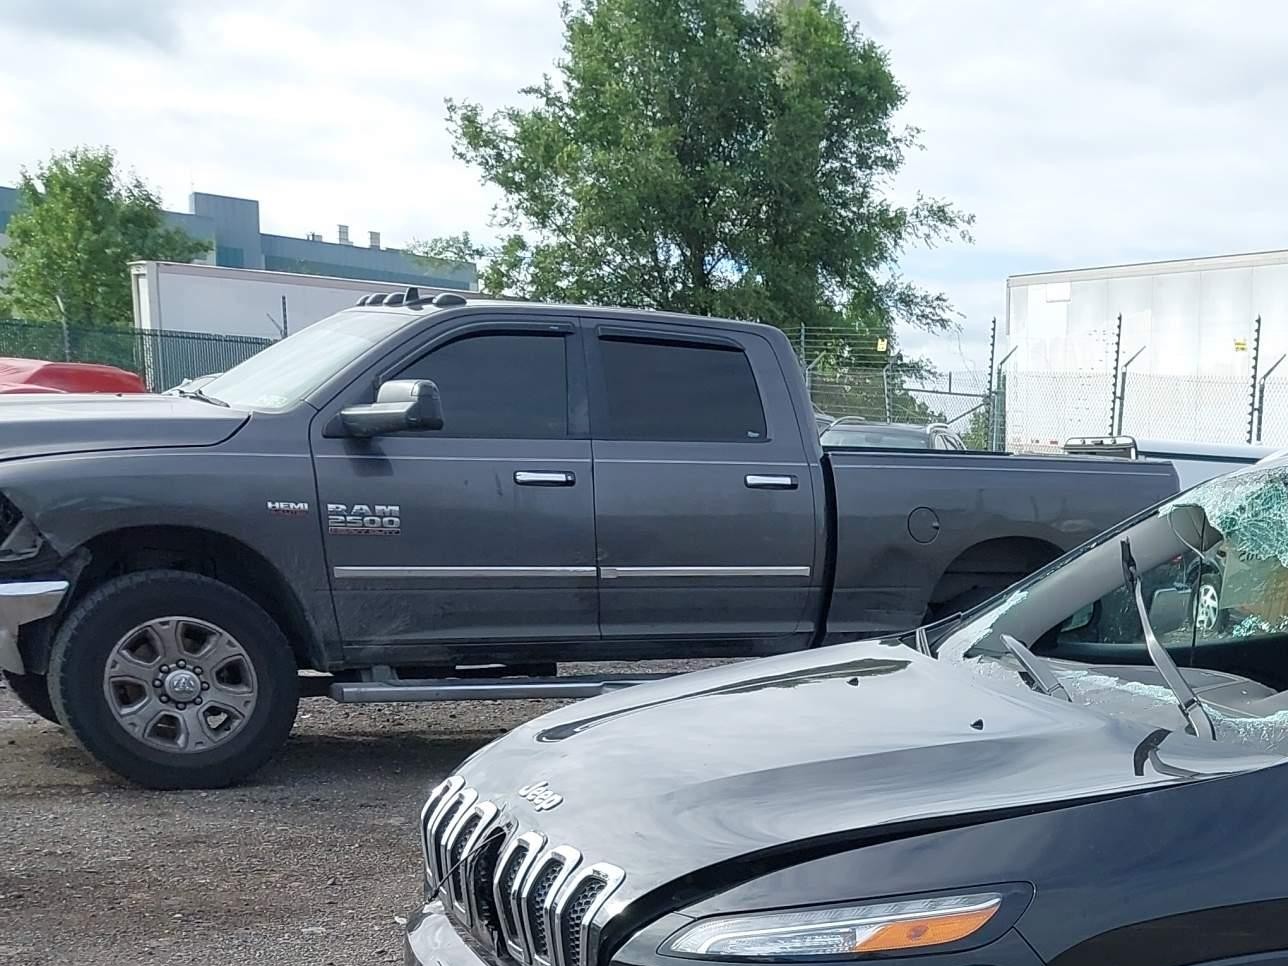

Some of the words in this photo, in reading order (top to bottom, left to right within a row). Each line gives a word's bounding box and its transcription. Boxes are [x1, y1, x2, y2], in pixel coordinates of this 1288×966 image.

[267, 501, 309, 511] HEMI
[327, 504, 400, 516] RAM
[328, 516, 401, 528] 2500
[518, 780, 564, 812] Jeep
